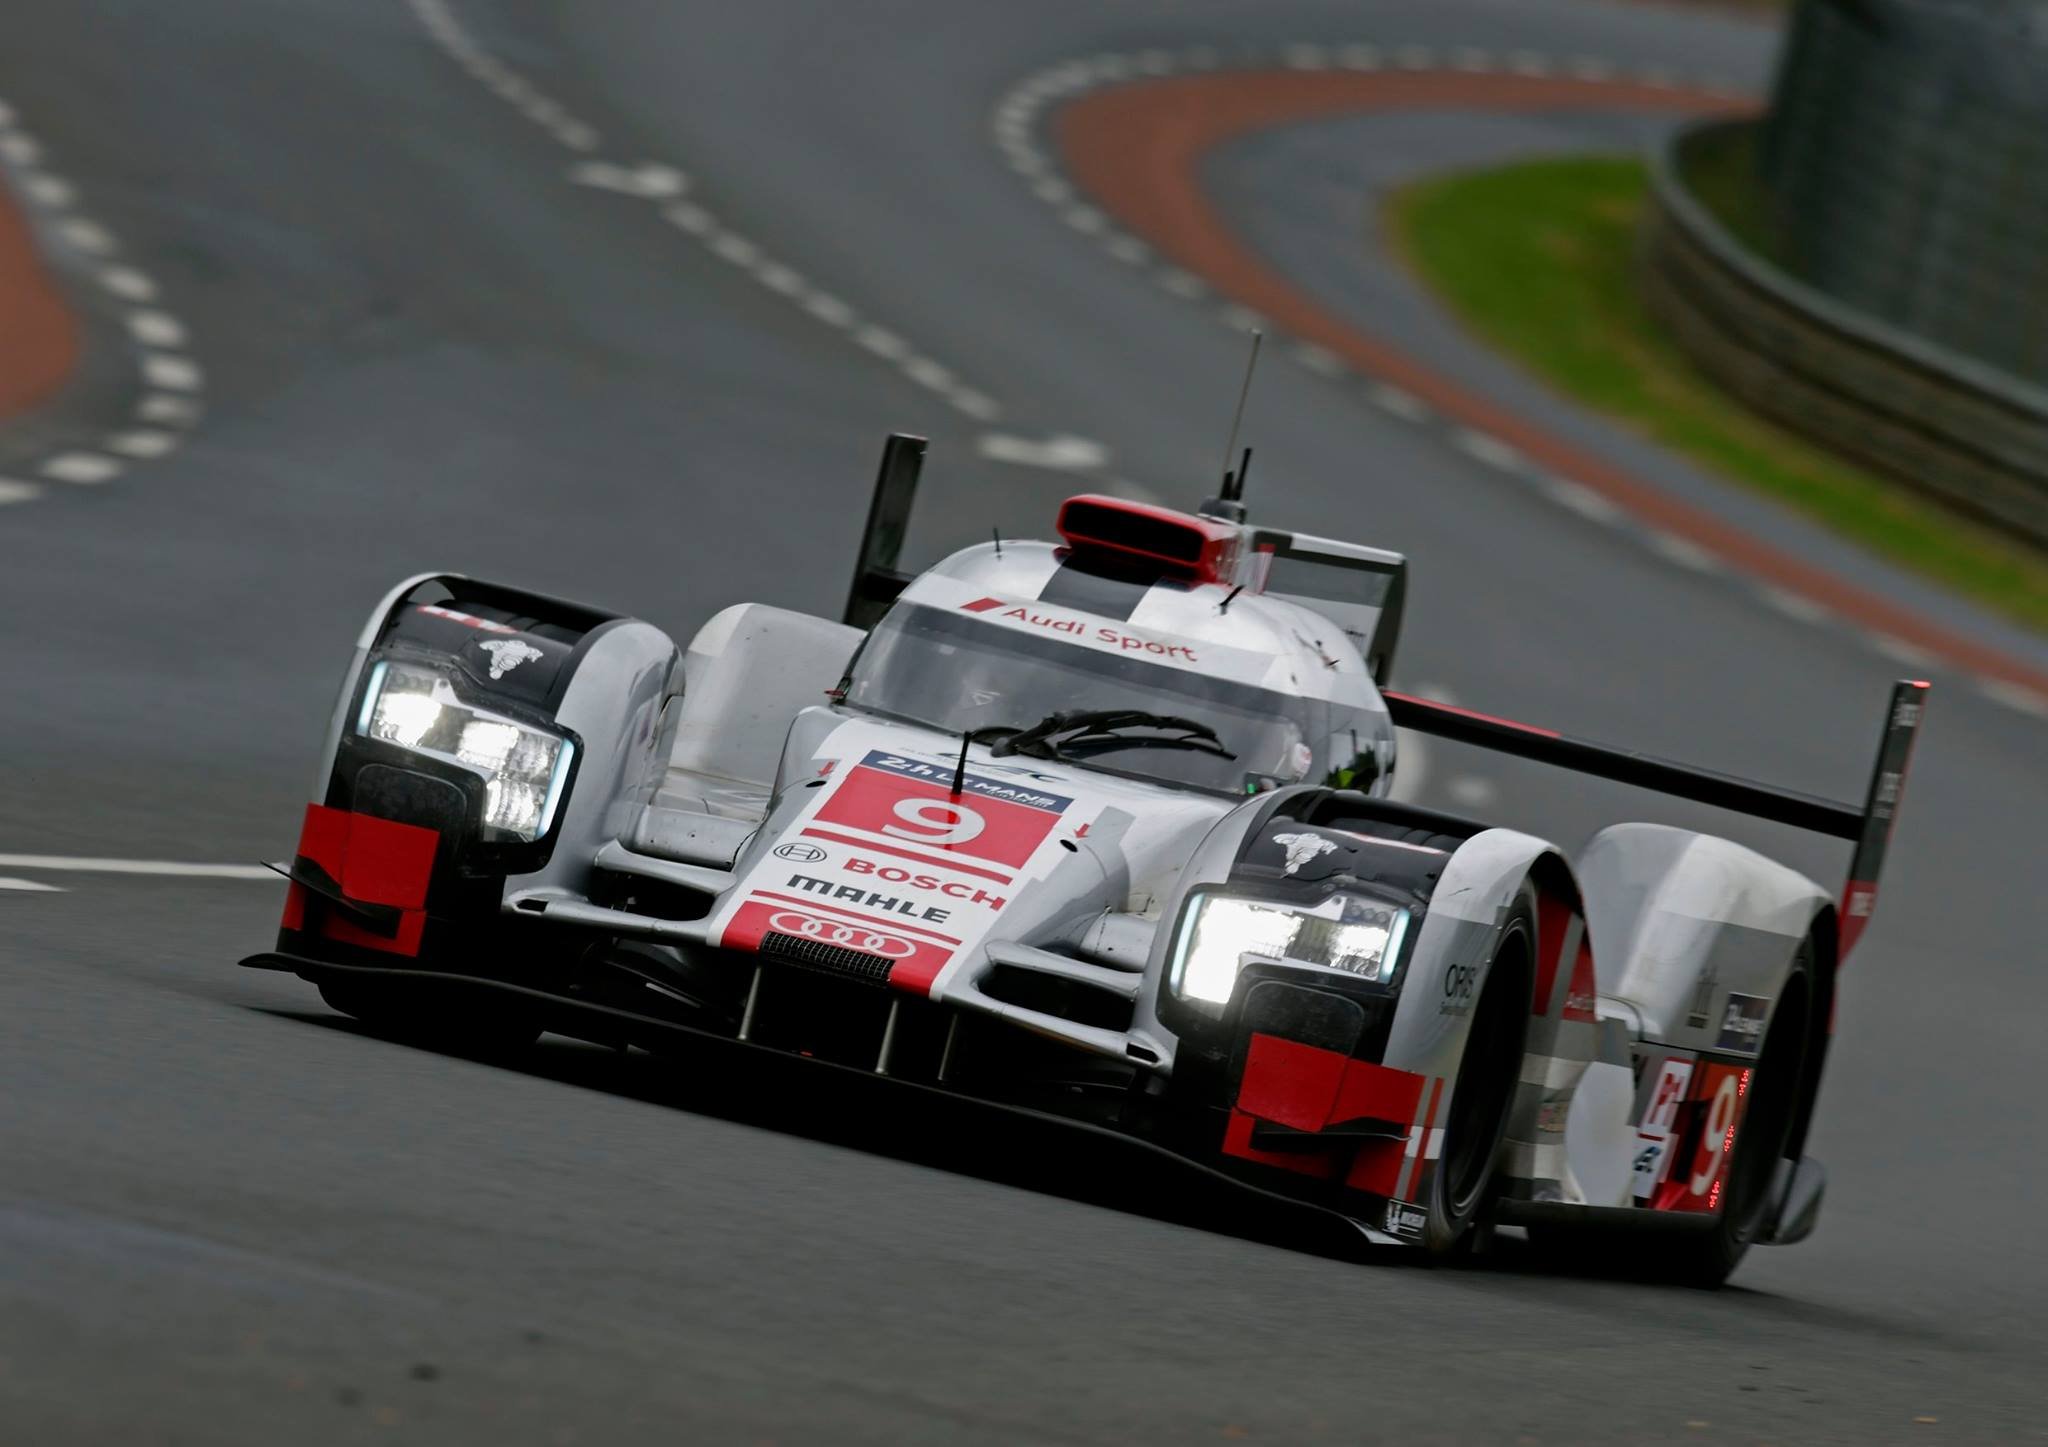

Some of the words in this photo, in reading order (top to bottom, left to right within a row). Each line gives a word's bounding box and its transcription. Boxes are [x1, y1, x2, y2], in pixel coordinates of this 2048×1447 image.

[1002, 608, 1086, 635] Audi
[1096, 628, 1197, 662] Sport
[882, 798, 985, 845] 9
[786, 874, 951, 924] MAHLE
[842, 857, 1007, 912] BOSCH
[1690, 1074, 1738, 1196] 9
